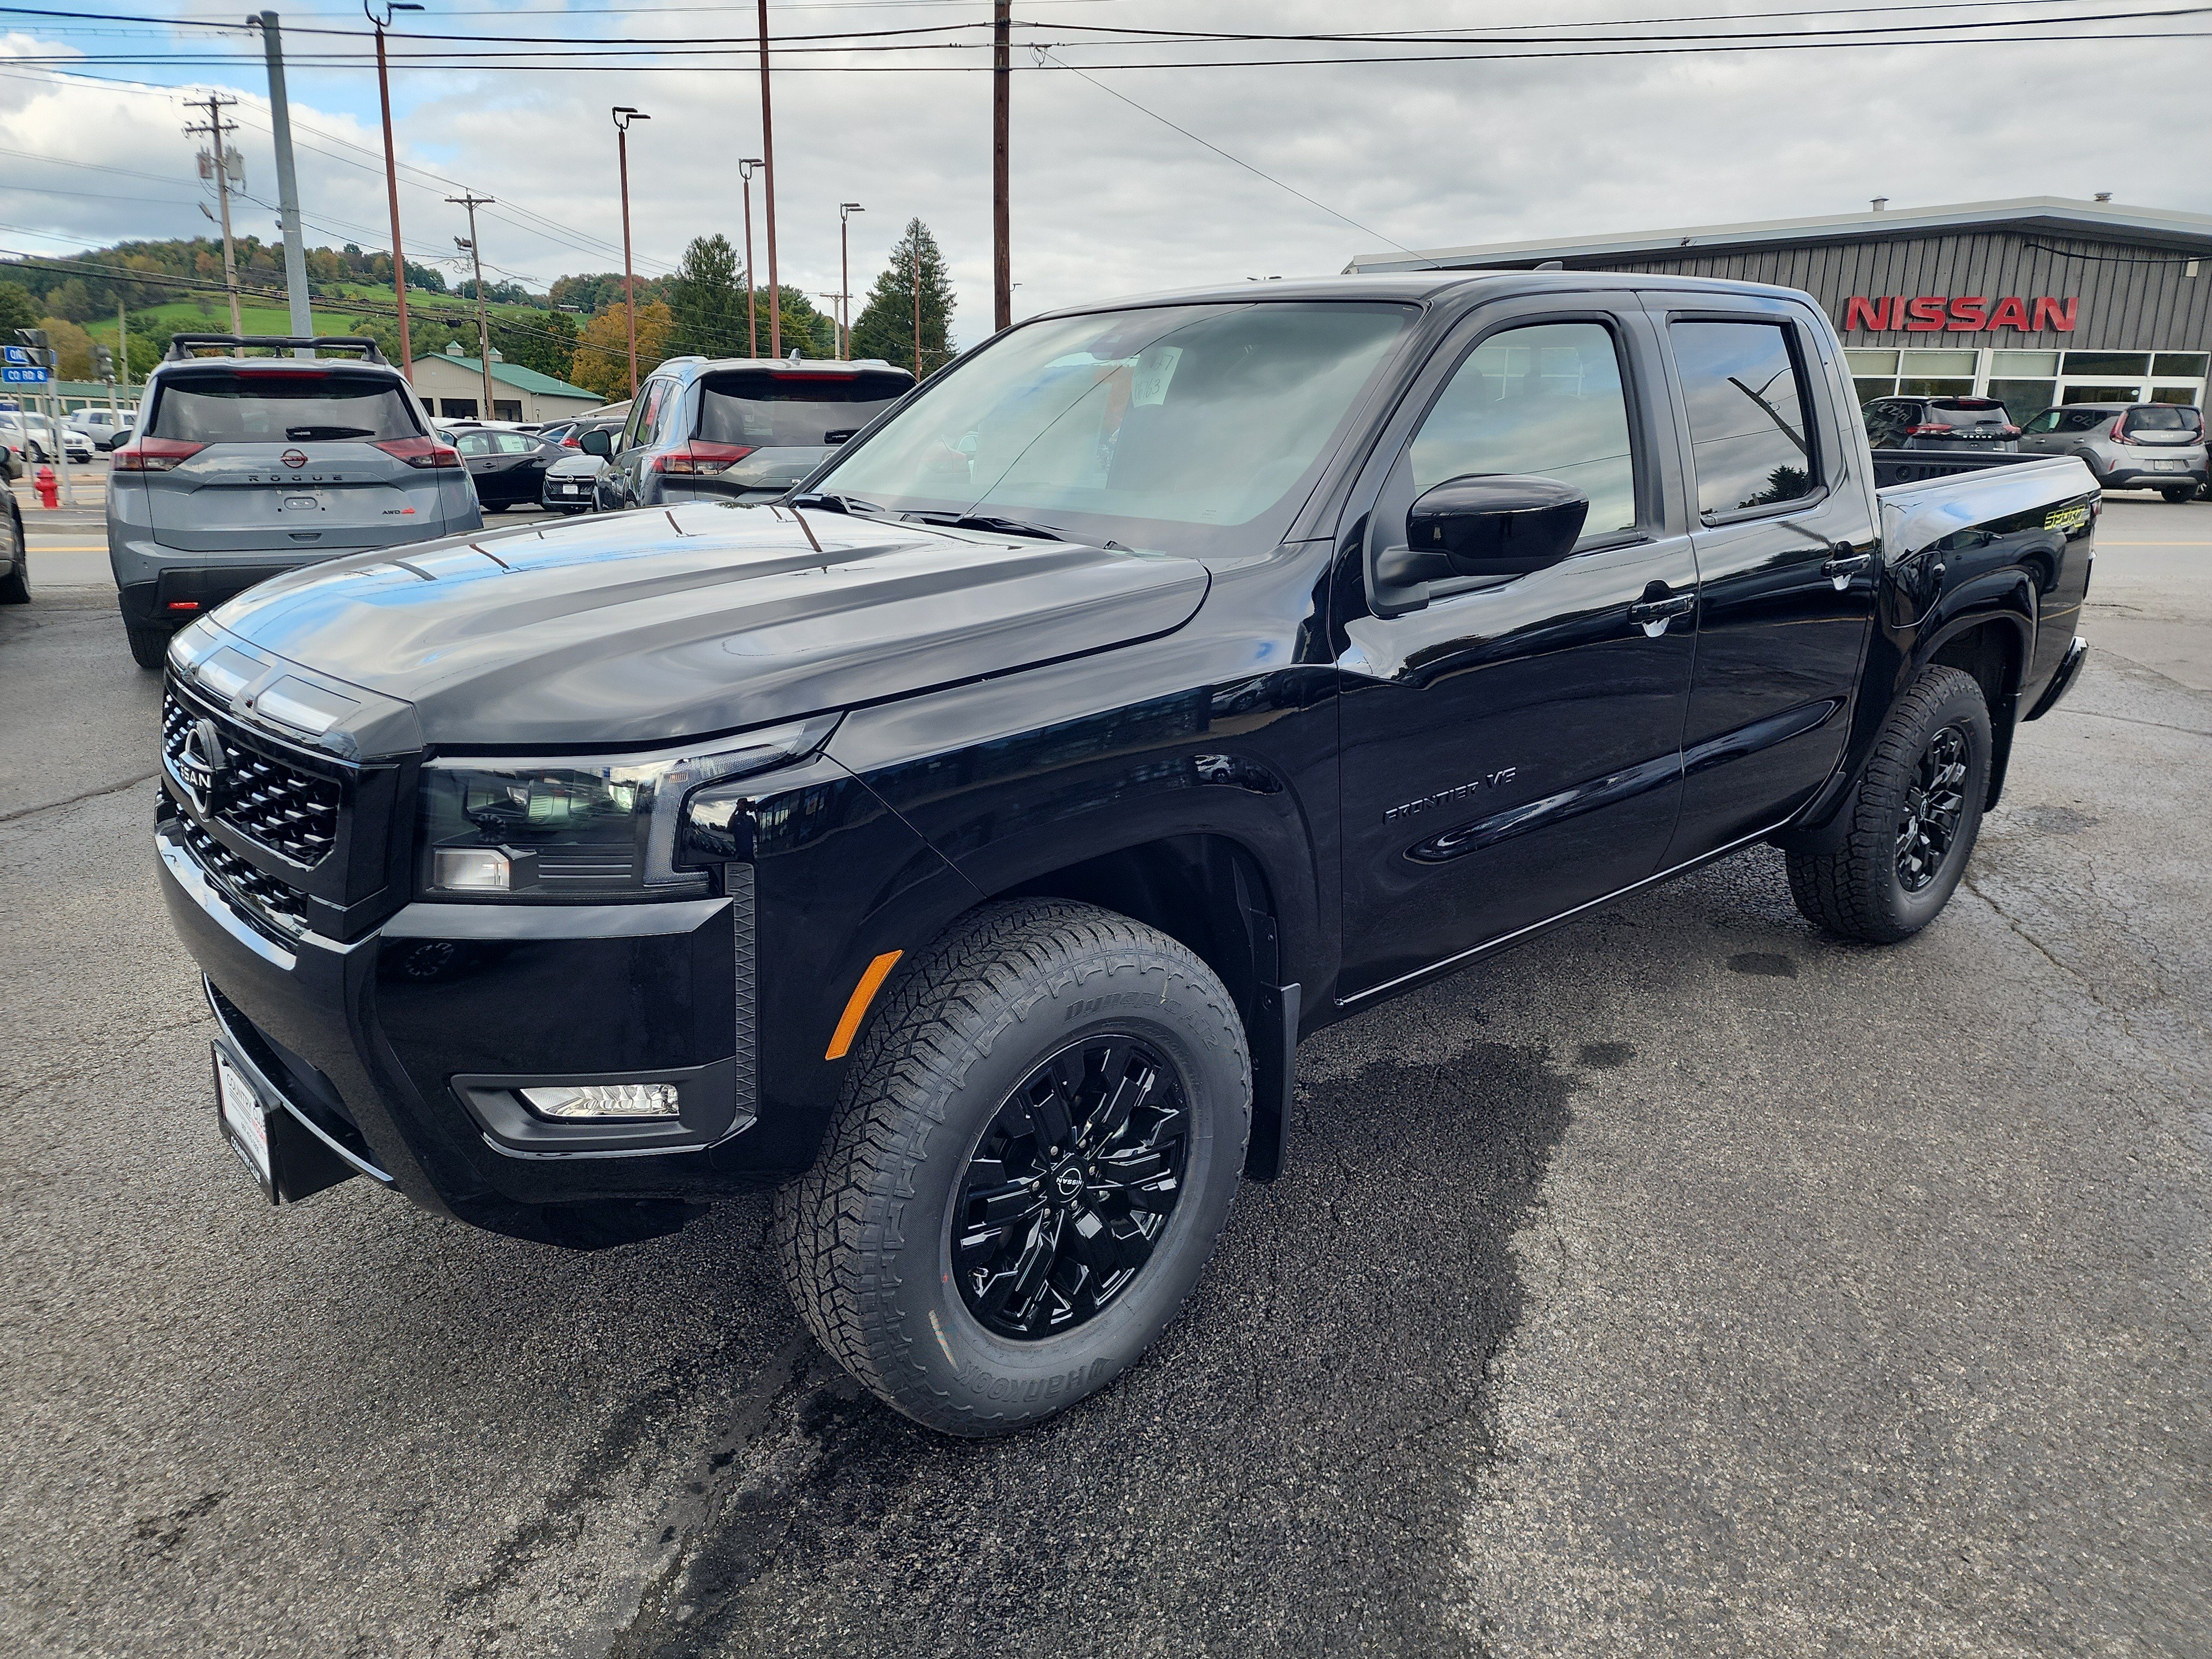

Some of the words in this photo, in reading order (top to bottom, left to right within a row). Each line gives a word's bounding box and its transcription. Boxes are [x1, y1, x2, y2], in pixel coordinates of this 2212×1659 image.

[1845, 296, 2078, 331] NISSAN
[8, 370, 20, 380] CO
[22, 370, 35, 380] RD
[1383, 781, 1480, 825] FRONTIER
[1485, 766, 1516, 789] V6
[227, 1073, 252, 1113] COUNTRY
[231, 1136, 249, 1168] COUNTRY
[1056, 1177, 1082, 1185] NISSAN
